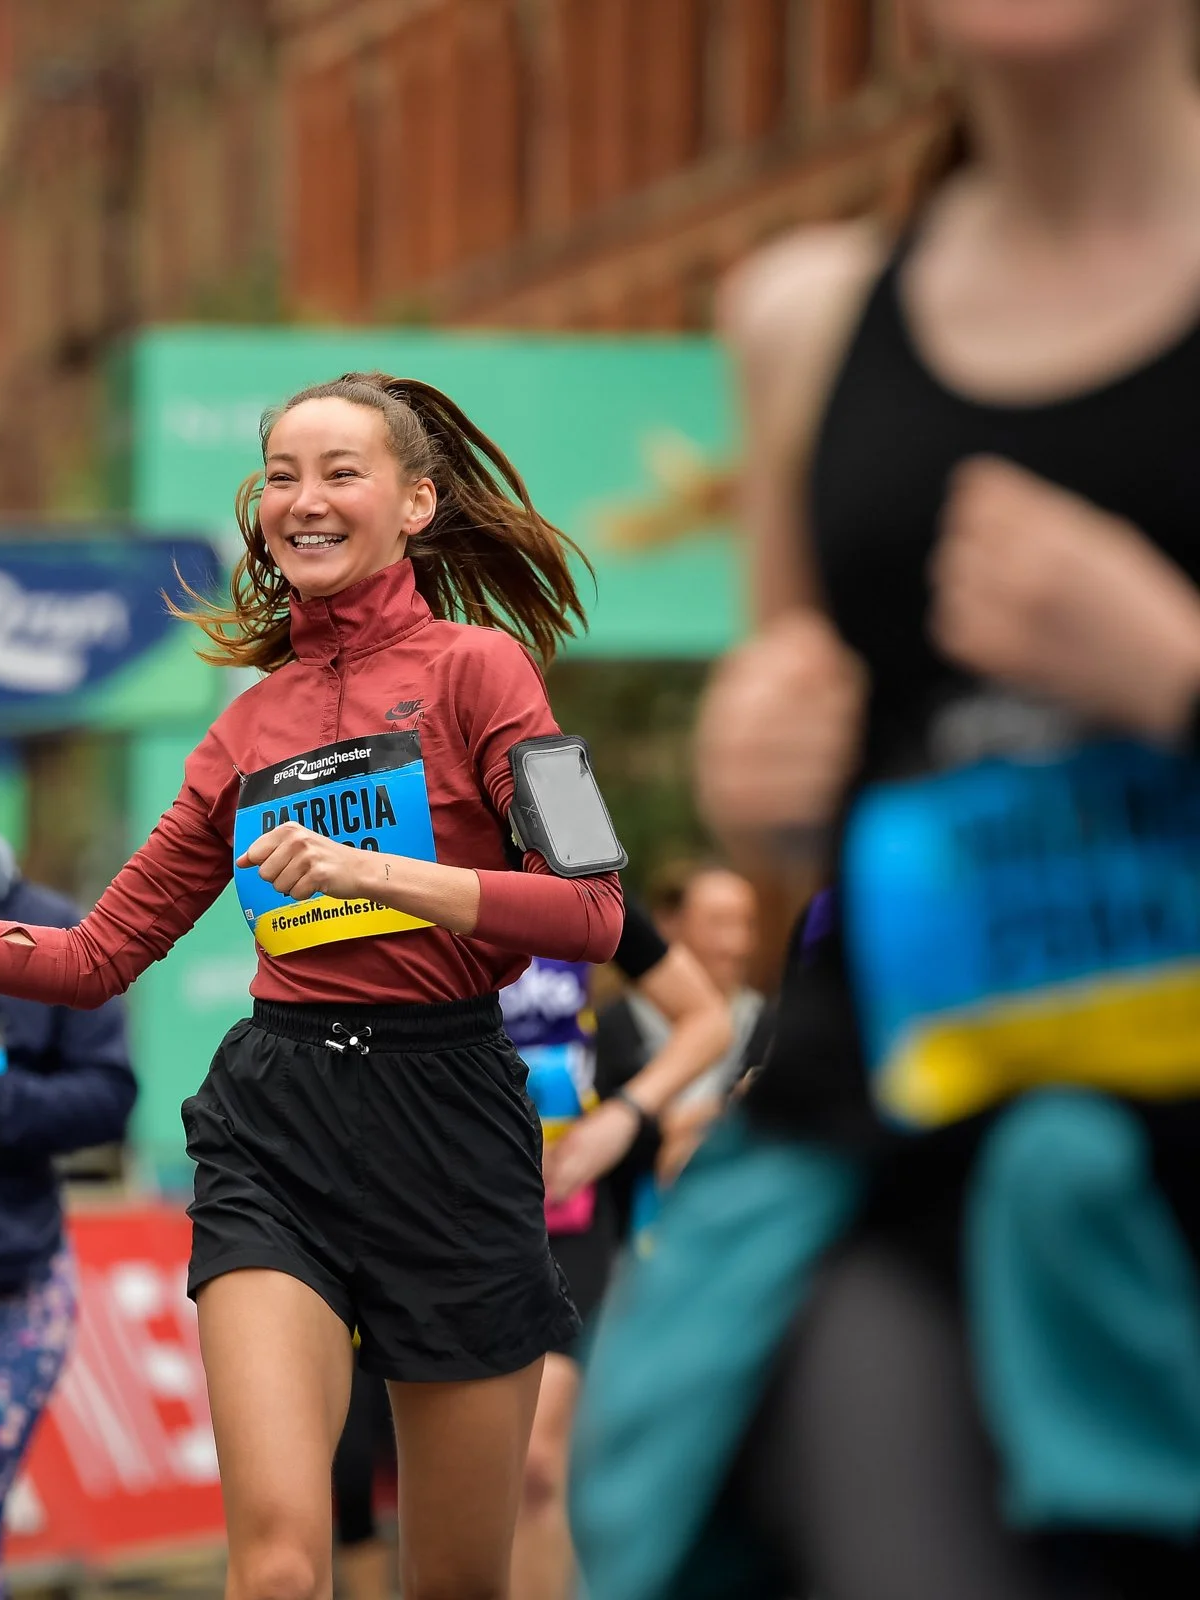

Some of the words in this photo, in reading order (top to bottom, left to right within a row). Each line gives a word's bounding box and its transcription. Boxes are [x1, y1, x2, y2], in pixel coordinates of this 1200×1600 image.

[273, 764, 299, 784] great
[307, 748, 372, 771] manchester
[318, 766, 337, 778] run
[272, 900, 390, 933] #GreatMancheste
